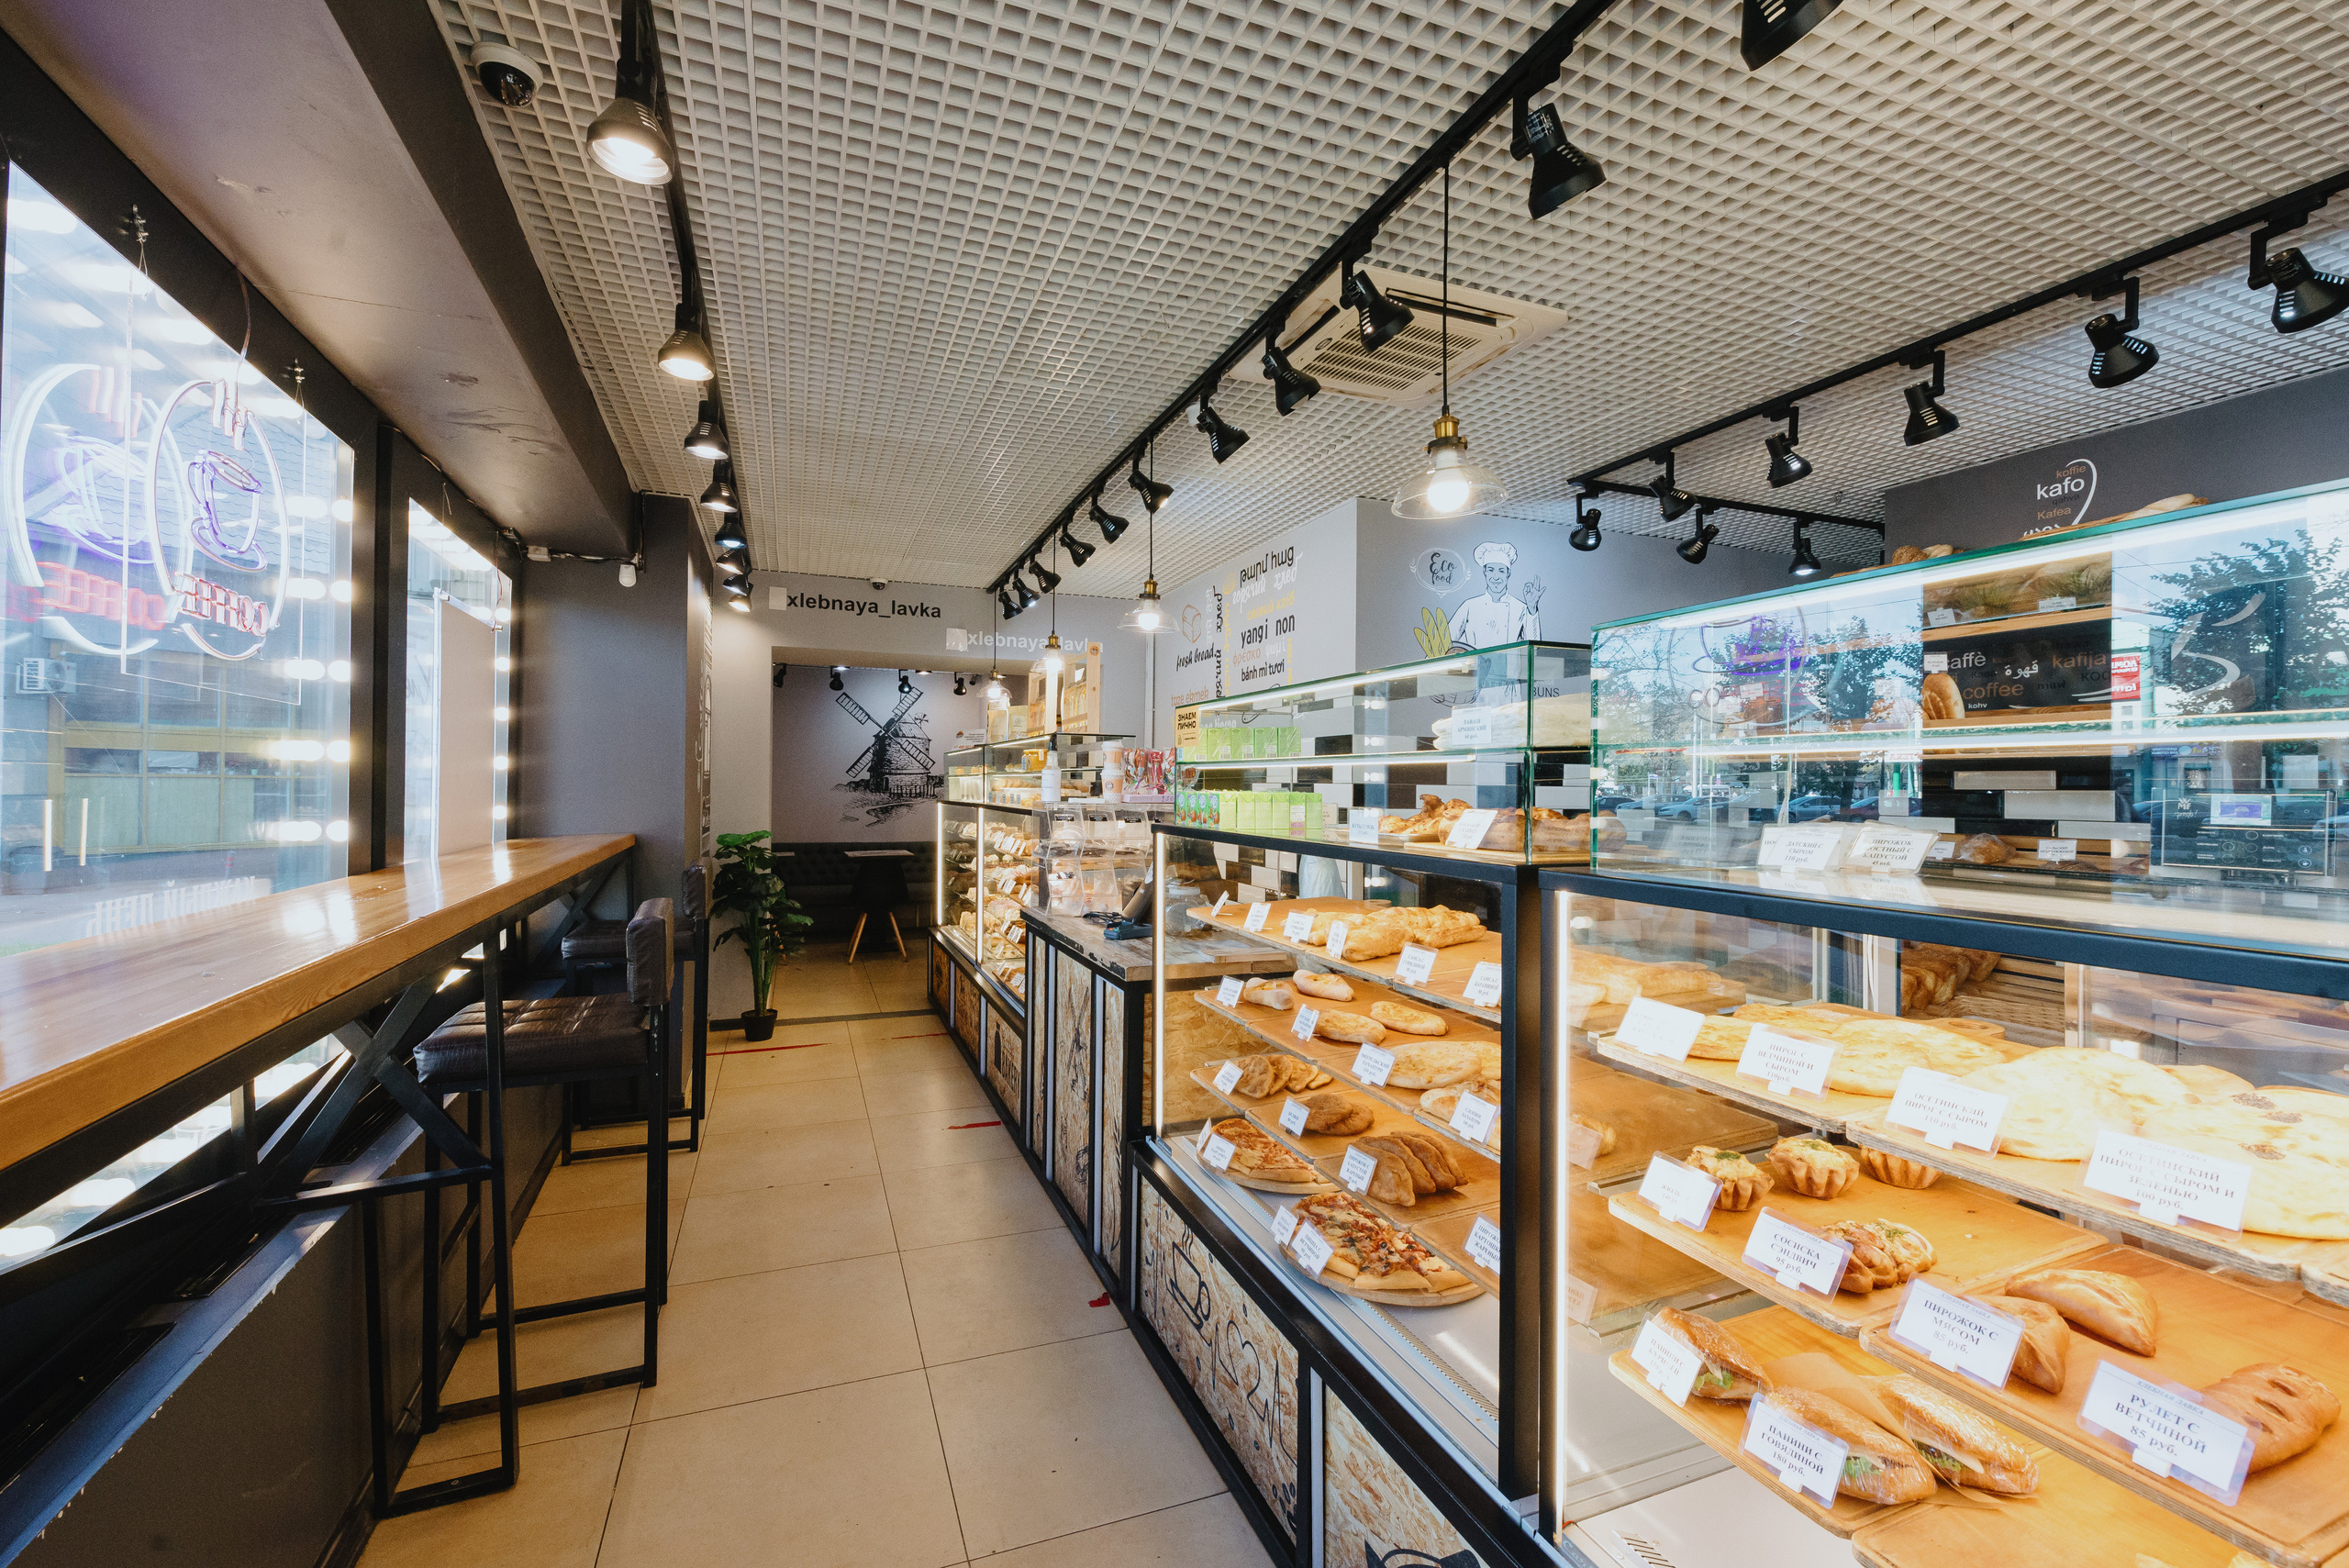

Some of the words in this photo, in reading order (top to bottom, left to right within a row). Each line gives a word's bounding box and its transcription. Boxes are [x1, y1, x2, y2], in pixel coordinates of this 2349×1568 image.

[2055, 464, 2087, 478] koffie
[2036, 476, 2086, 501] kafo
[2037, 506, 2072, 520] Kafea
[1429, 550, 1457, 575] Eco
[1431, 572, 1453, 585] food
[786, 594, 941, 618] xlebnaya_lavka
[967, 631, 1104, 653] xlebnayalav
[1241, 617, 1269, 650] yangi
[1275, 614, 1296, 637] non
[2004, 659, 2039, 680] قهوة
[2053, 651, 2107, 670] kafija
[1962, 682, 2024, 700] coffee
[1177, 711, 1197, 722] ЗНАЕМ
[1177, 720, 1197, 730] ЛИЧНО
[2178, 797, 2191, 810] WMF
[1786, 840, 1818, 849] ДАТСКИЙ
[1862, 852, 1909, 861] КАПУСТОЙ
[1757, 1050, 1805, 1067] ВЕТЧИНОЙ
[1769, 1043, 1797, 1056] ПИРОГ
[1765, 1061, 1799, 1076] СЫРОМ
[1904, 1099, 1936, 1112] ПИРОГ
[1947, 1111, 1988, 1129] СЫРОМ
[1913, 1092, 1985, 1118] ОСЕТИНСКИЙ
[2099, 1153, 2145, 1174] ПИРОГ
[2163, 1172, 2222, 1195] СЫРОМ
[2225, 1188, 2235, 1199] И
[2118, 1147, 2221, 1183] ОСЕТИНСКИЙ
[2126, 1174, 2199, 1202] ЗЕЛЕНЬЮ
[2157, 1195, 2184, 1210] руб.
[1475, 1231, 1500, 1253] КАРТОШК
[1478, 1225, 1500, 1242] ПИРОЖО
[1771, 1242, 1817, 1269] СЭНДВИЧ
[1774, 1233, 1820, 1260] СОСИСКА
[1776, 1256, 1786, 1265] 95
[1786, 1262, 1803, 1275] руб.
[1940, 1293, 1968, 1310] ХЛЕБНАЯ
[1968, 1305, 1991, 1319] ЛАВКА
[1923, 1299, 1987, 1335] ПИРОЖОК
[1988, 1330, 1998, 1341] С
[1931, 1316, 1980, 1346] МЯСОМ
[1932, 1330, 1945, 1341] 85
[1946, 1338, 1968, 1354] руб.
[2135, 1379, 2174, 1400] ХЛЕБНАЯ
[2174, 1396, 2204, 1416] ЛАВКА
[2130, 1394, 2185, 1426] РУЛЕТ
[2187, 1422, 2199, 1434] С
[2115, 1402, 2206, 1454] ВЕТЧИНОЙ
[1761, 1432, 1824, 1474] ГОВЯДИНОЙ
[1769, 1424, 1813, 1455] ПАНИНИ
[1814, 1451, 1823, 1462] С
[2130, 1425, 2145, 1440] 85
[2148, 1437, 2177, 1457] руб.
[1773, 1451, 1787, 1464] 180
[1788, 1462, 1806, 1477] руб.
